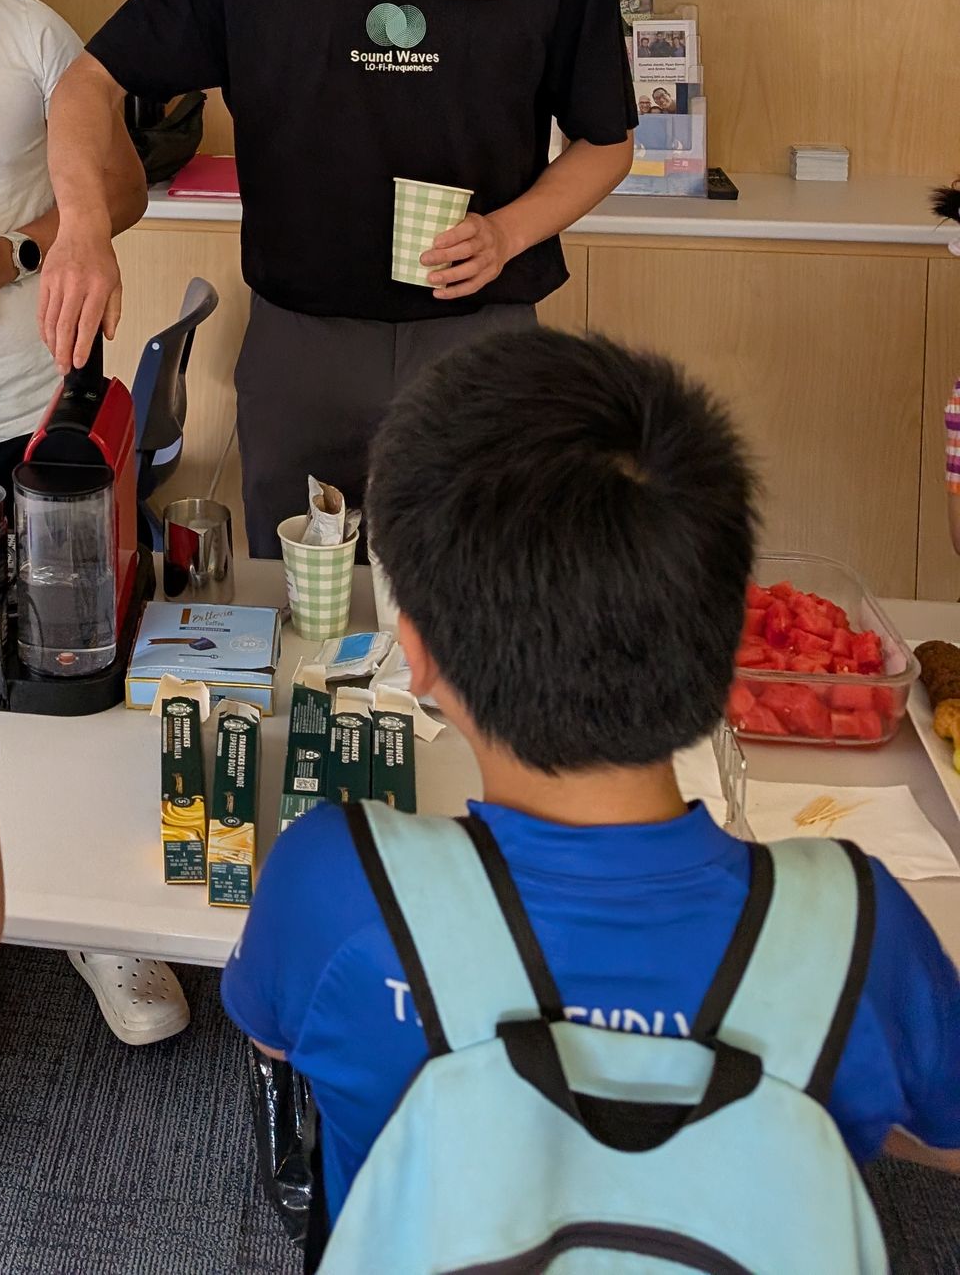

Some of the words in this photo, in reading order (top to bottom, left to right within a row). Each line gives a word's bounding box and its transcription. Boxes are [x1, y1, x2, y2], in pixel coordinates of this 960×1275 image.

[350, 50, 392, 63] Sound
[396, 50, 440, 63] Waves
[183, 717, 191, 748] STARBUCKS
[342, 728, 351, 746] HOUSE
[386, 731, 394, 749] HOUSE
[229, 733, 238, 760] ESPRESSO
[237, 734, 247, 765] STARBUCKS
[341, 746, 350, 763] BLEND
[351, 729, 360, 762] STARBUCKS
[395, 732, 404, 765] STARBUCKS
[386, 749, 394, 767] BLEND
[227, 760, 237, 778] ROAST
[236, 766, 246, 788] BLONDE
